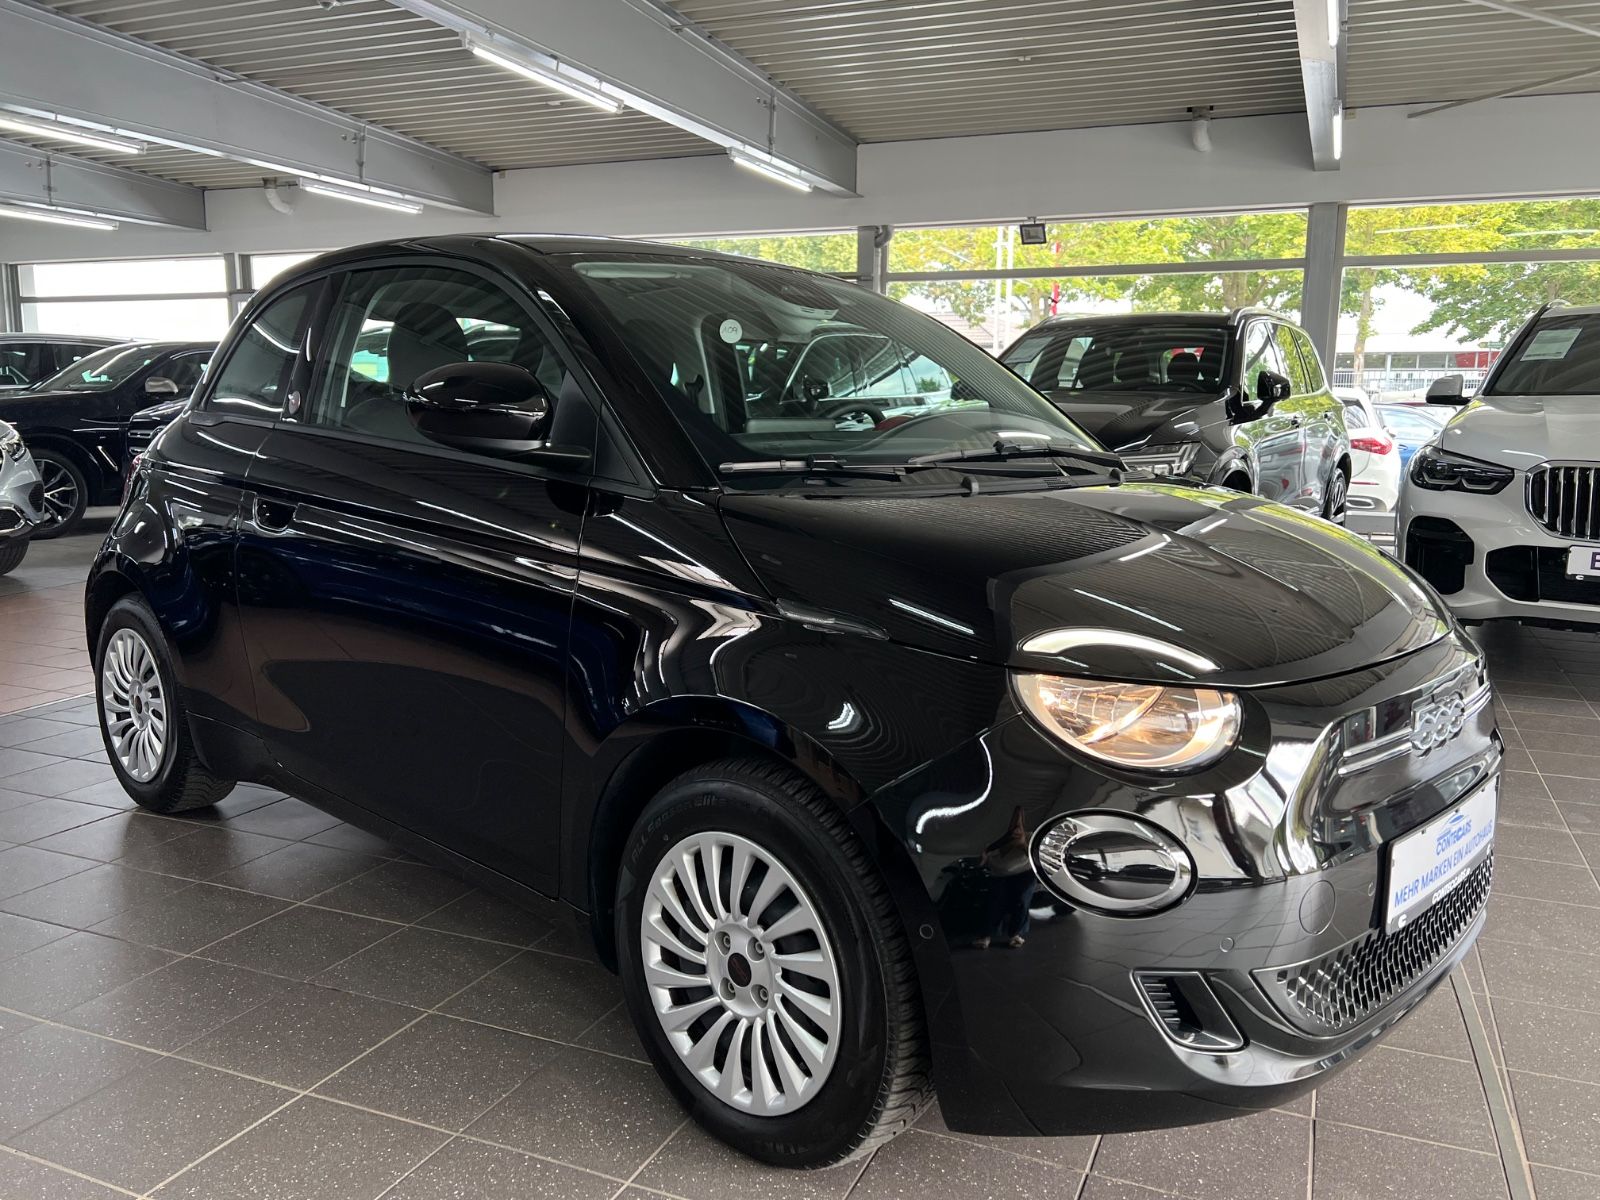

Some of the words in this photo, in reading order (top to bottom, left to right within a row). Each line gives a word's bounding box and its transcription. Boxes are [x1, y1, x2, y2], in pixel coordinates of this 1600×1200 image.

[1394, 879, 1420, 908] MEHR
[1421, 855, 1452, 890] MARKEN
[1453, 847, 1464, 868] EIN
[1464, 819, 1493, 859] AUTOHAUS
